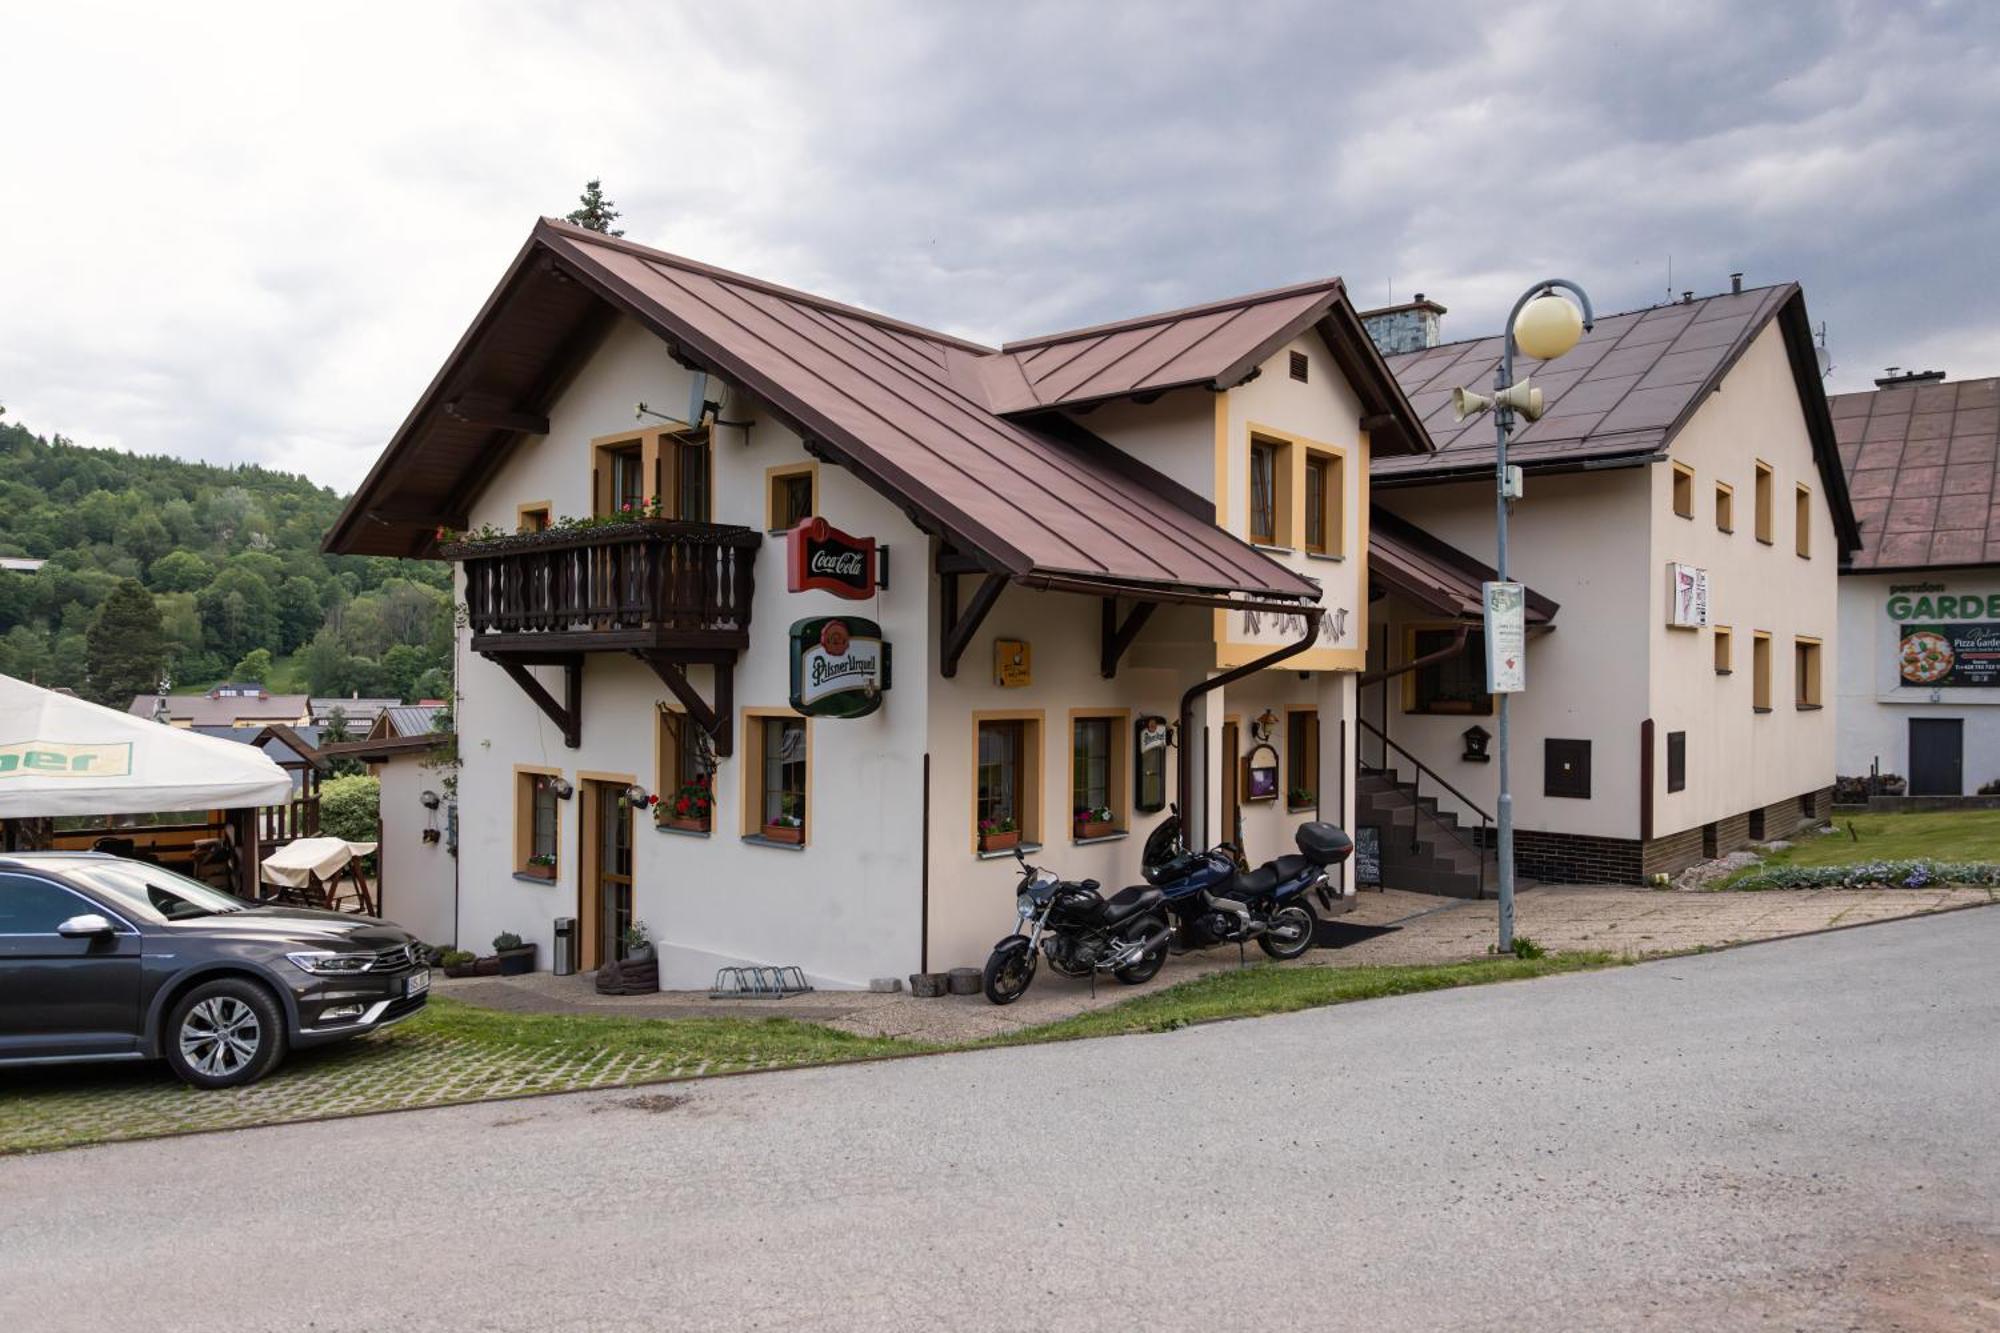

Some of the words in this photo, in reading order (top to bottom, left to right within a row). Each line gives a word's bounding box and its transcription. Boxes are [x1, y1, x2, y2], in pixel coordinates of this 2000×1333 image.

[811, 549, 863, 576] Coca-Cola
[1887, 595, 2000, 621] GARDE
[1954, 639, 1975, 647] Pizza
[812, 655, 848, 687] Pilsner
[848, 655, 875, 677] Urquell
